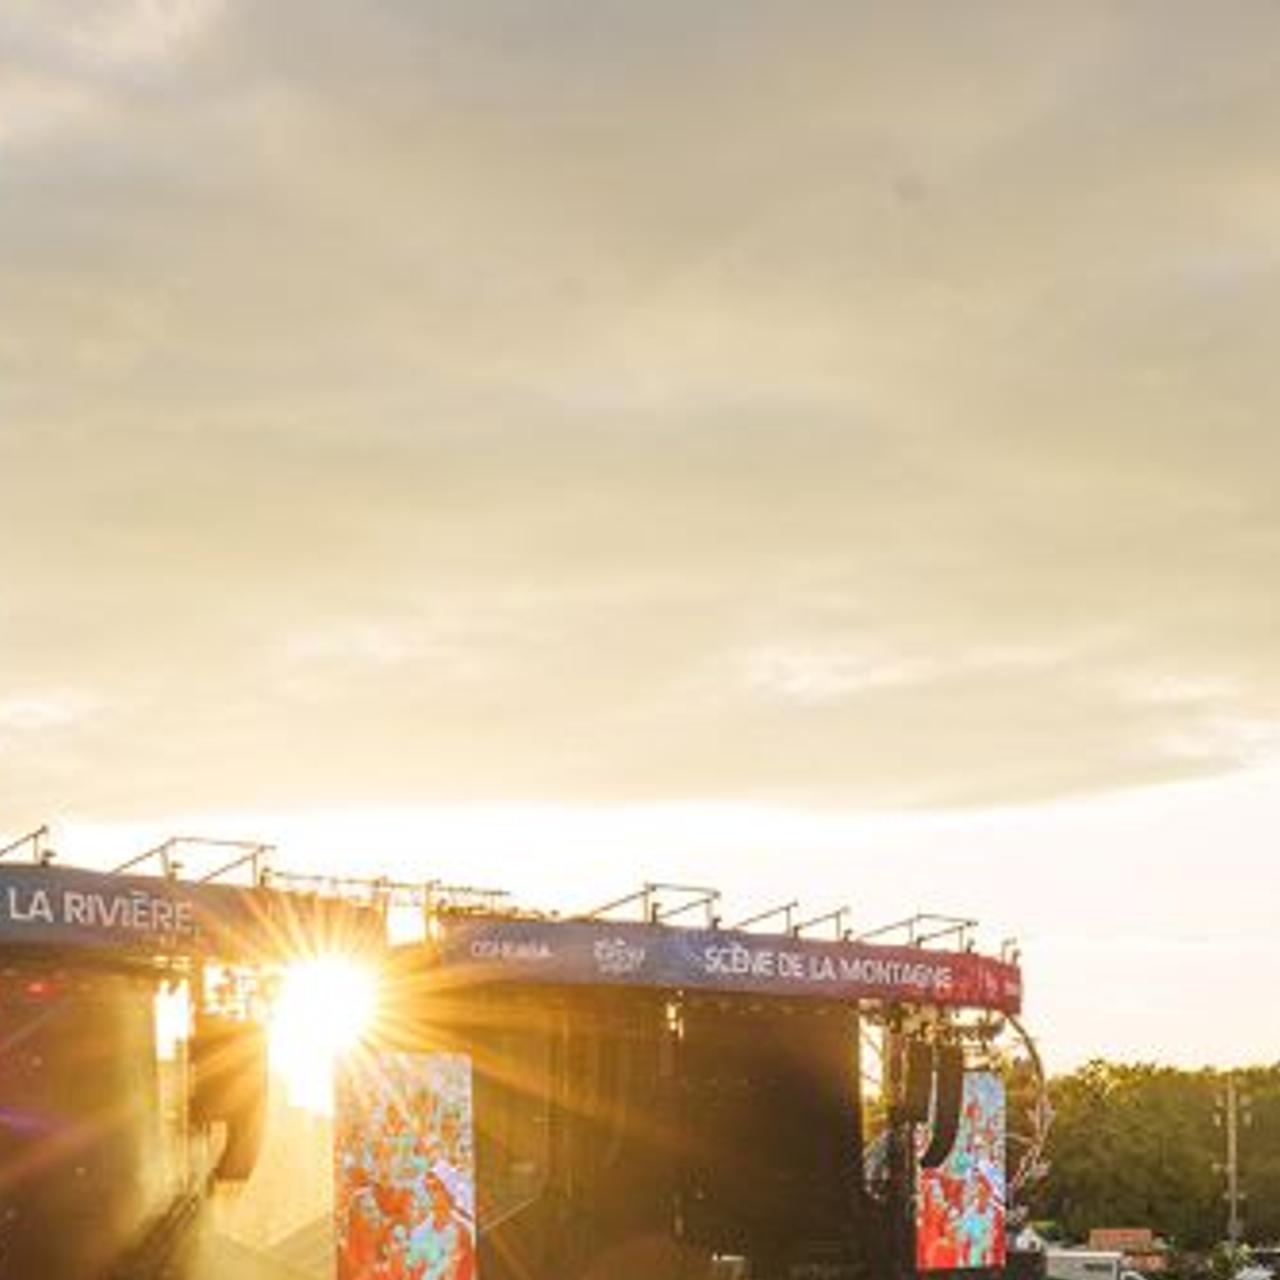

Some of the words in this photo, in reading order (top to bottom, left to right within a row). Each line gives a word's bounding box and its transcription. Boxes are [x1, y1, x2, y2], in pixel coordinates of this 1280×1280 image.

[7, 887, 54, 923] LA
[63, 889, 194, 933] RIVIÈRE
[779, 951, 804, 978] DE
[809, 955, 837, 981] LA
